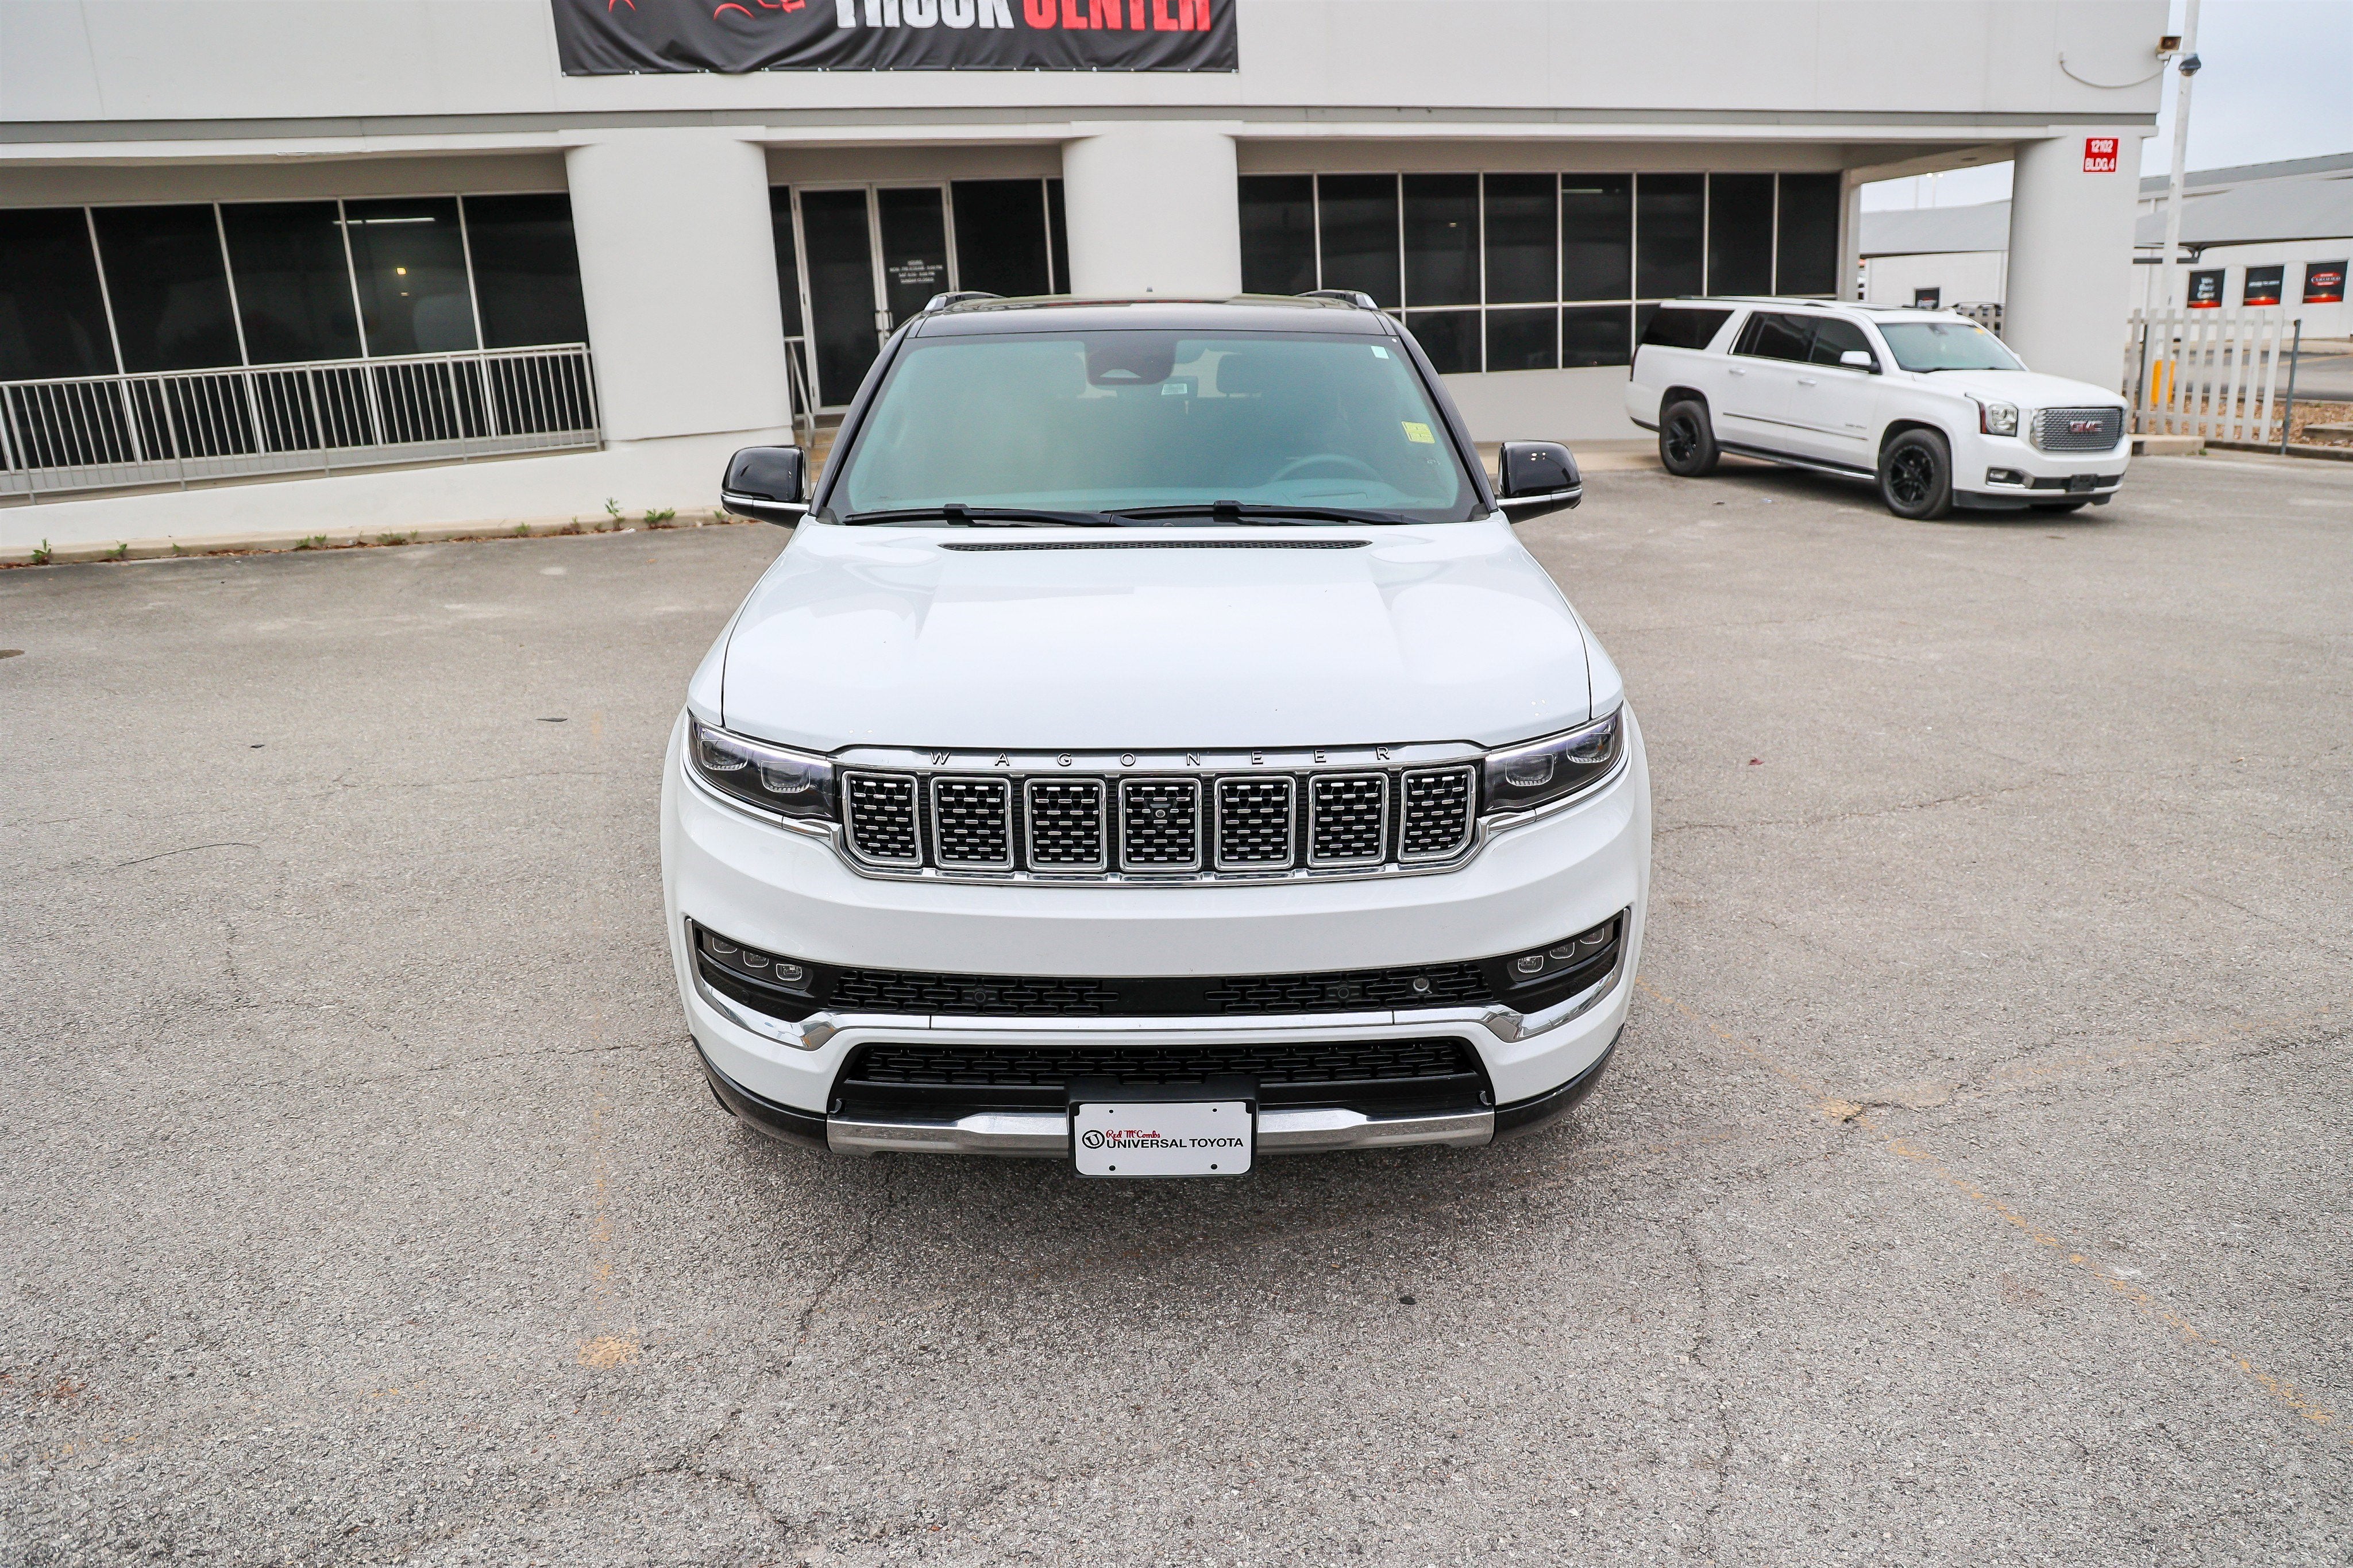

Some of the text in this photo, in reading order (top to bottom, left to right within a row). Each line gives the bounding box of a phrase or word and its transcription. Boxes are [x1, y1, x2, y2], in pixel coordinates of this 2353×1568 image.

[2069, 422, 2104, 432] GMC
[929, 747, 1391, 767] WAGONEER
[1106, 1129, 1160, 1141] Red McCombs
[1106, 1138, 1244, 1148] UNIVERSAL TOYOTA
